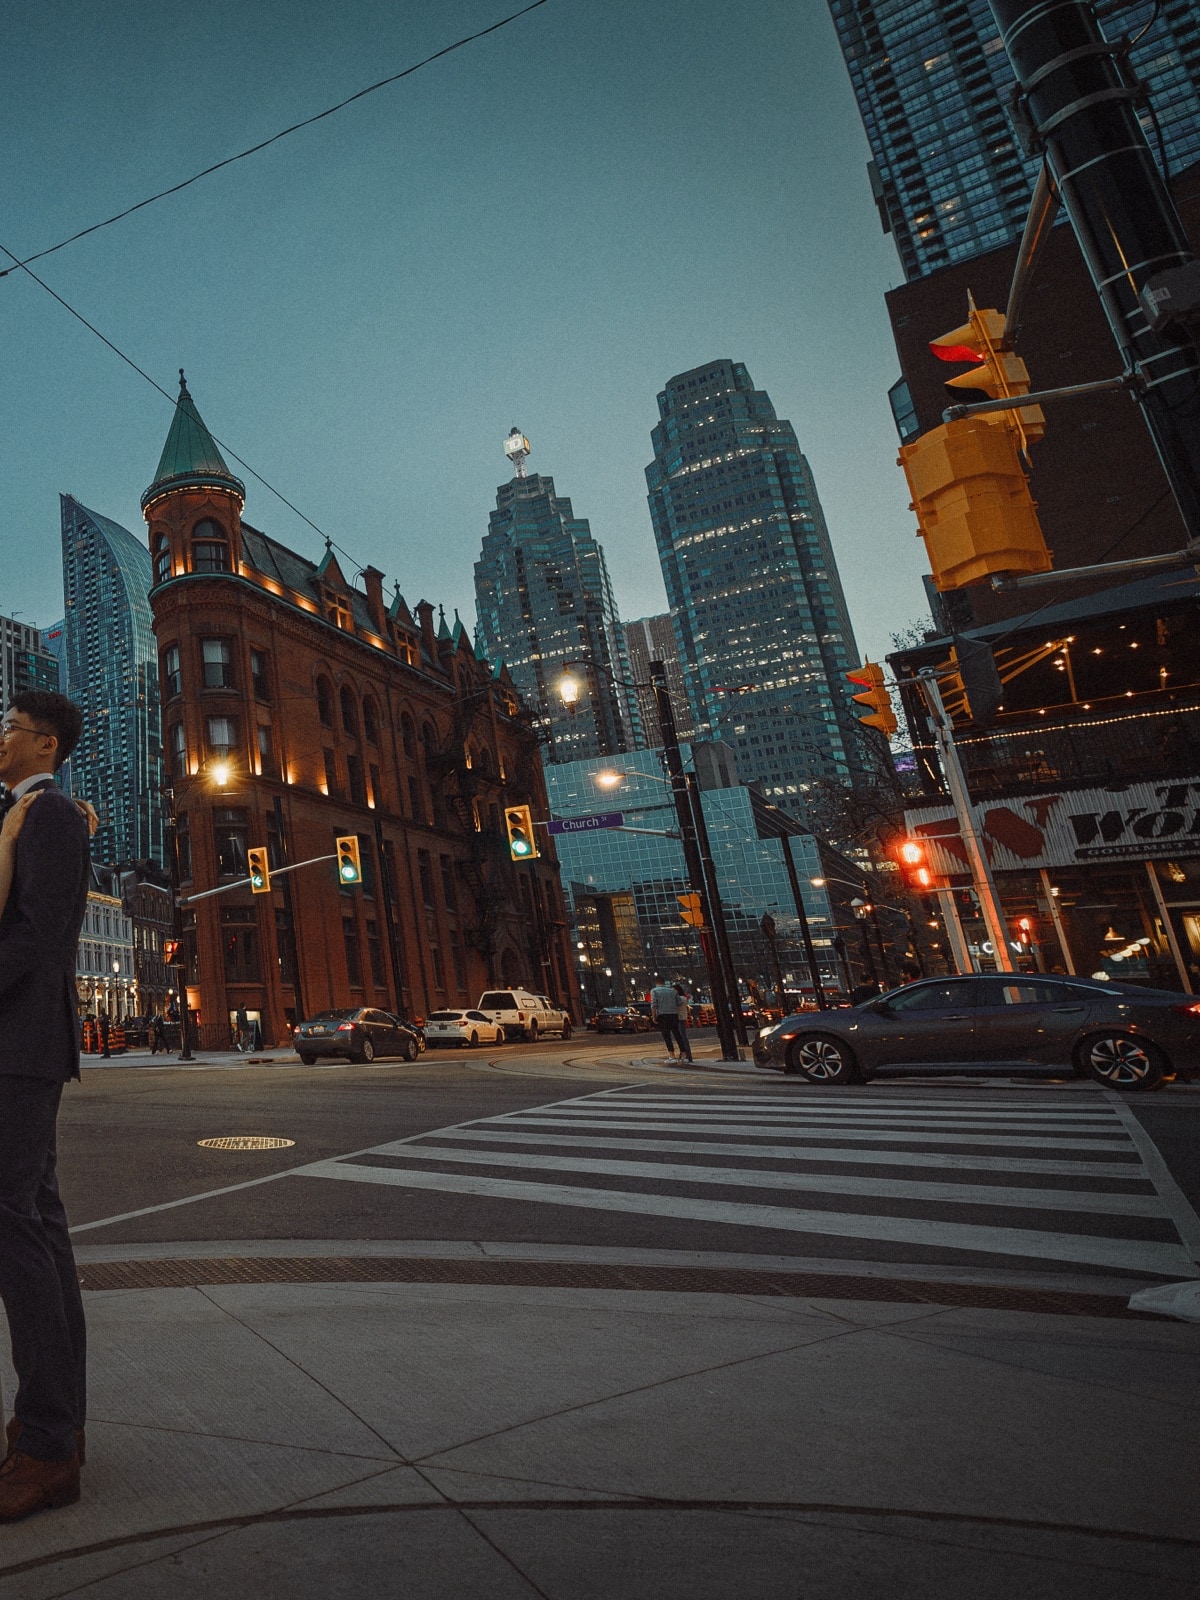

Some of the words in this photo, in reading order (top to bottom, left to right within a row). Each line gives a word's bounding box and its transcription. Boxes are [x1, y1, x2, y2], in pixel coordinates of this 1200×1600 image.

[505, 438, 522, 450] TD
[1155, 781, 1200, 809] T
[562, 817, 599, 830] Church
[1087, 842, 1187, 856] GOURMET
